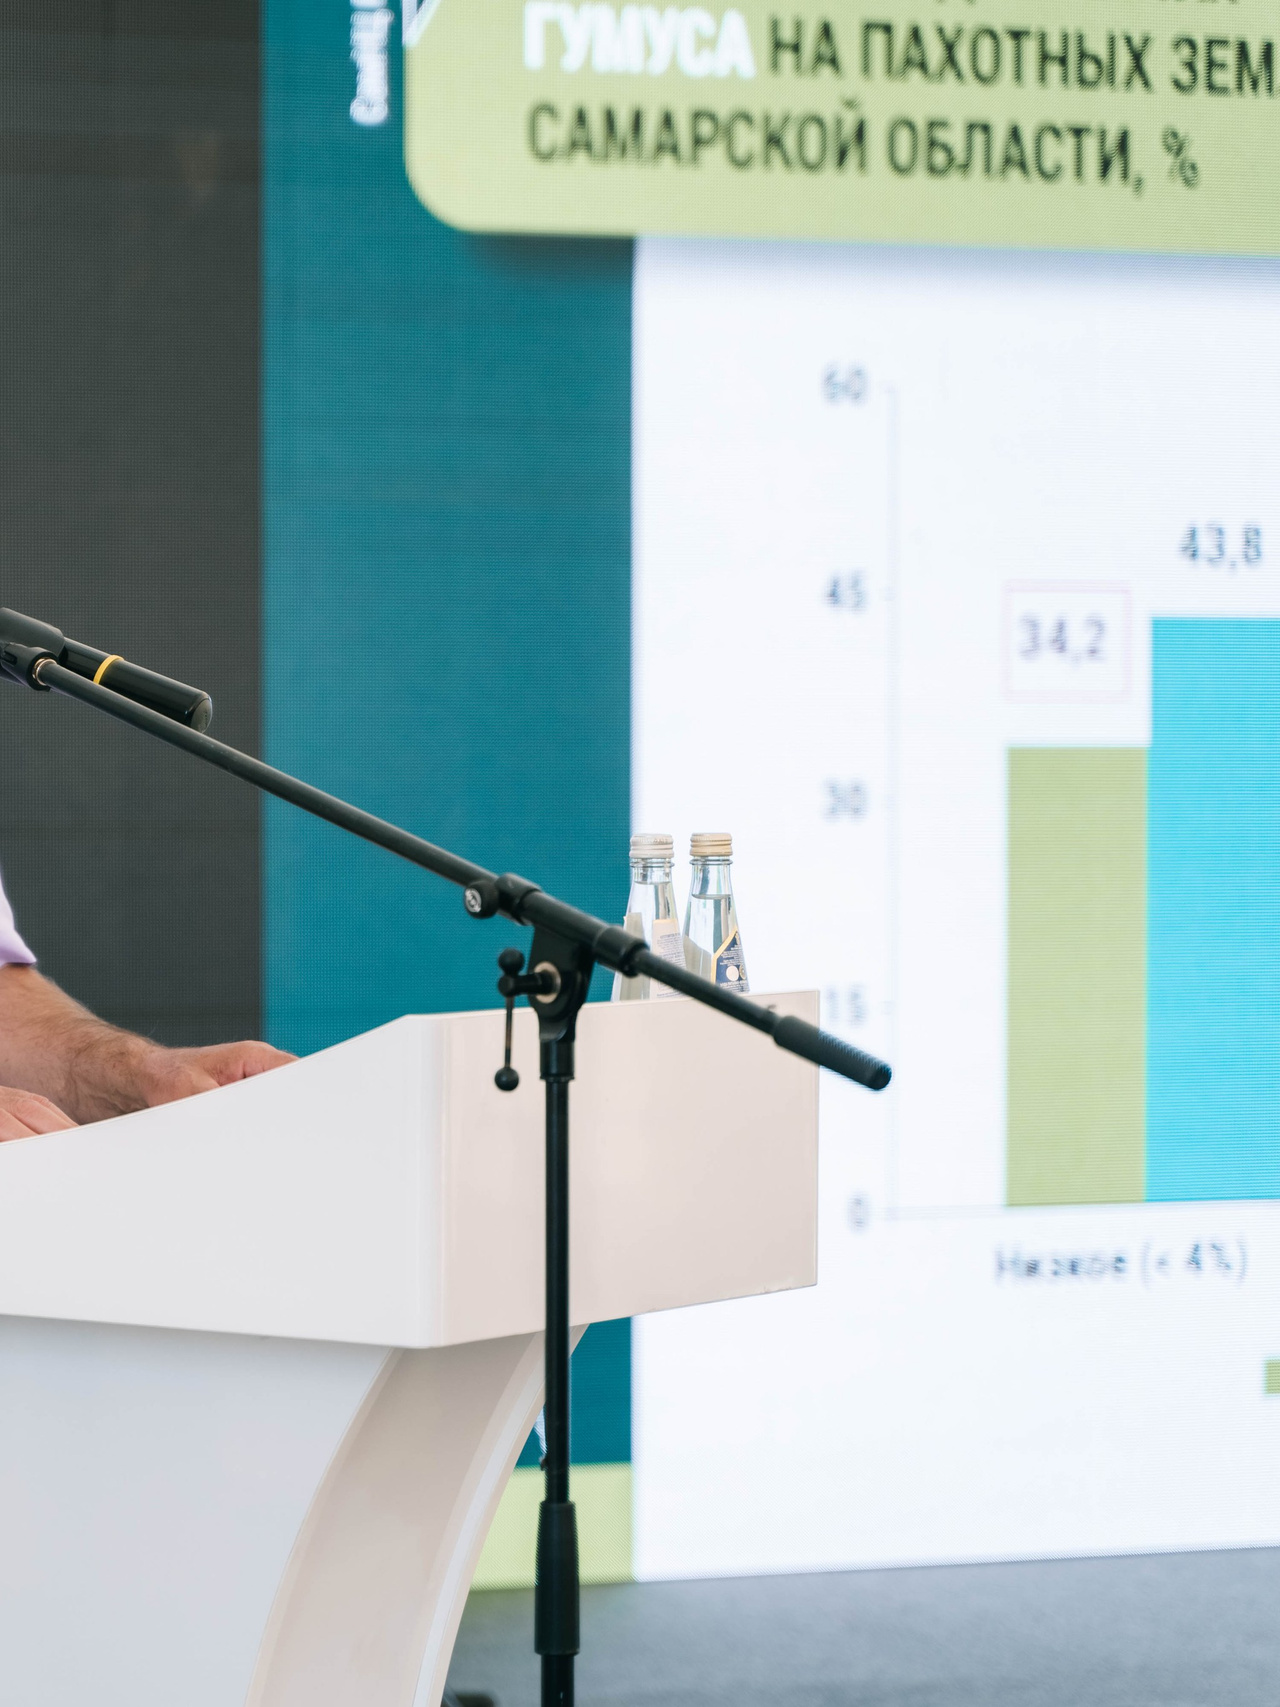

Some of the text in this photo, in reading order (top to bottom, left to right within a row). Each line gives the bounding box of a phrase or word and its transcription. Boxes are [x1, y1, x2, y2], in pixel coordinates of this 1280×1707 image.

[523, 3, 1276, 97] ГУМУСА НА ПАХОТНЫХ ЗЕМ
[529, 97, 1200, 195] САМАРСКОЙ ОБЛАСТИ, %
[821, 364, 868, 405] 60
[1177, 520, 1264, 575] 43,8
[823, 570, 868, 612] 45
[1019, 614, 1107, 667] 34,2
[824, 779, 868, 821] 30
[847, 1194, 870, 1232] 0
